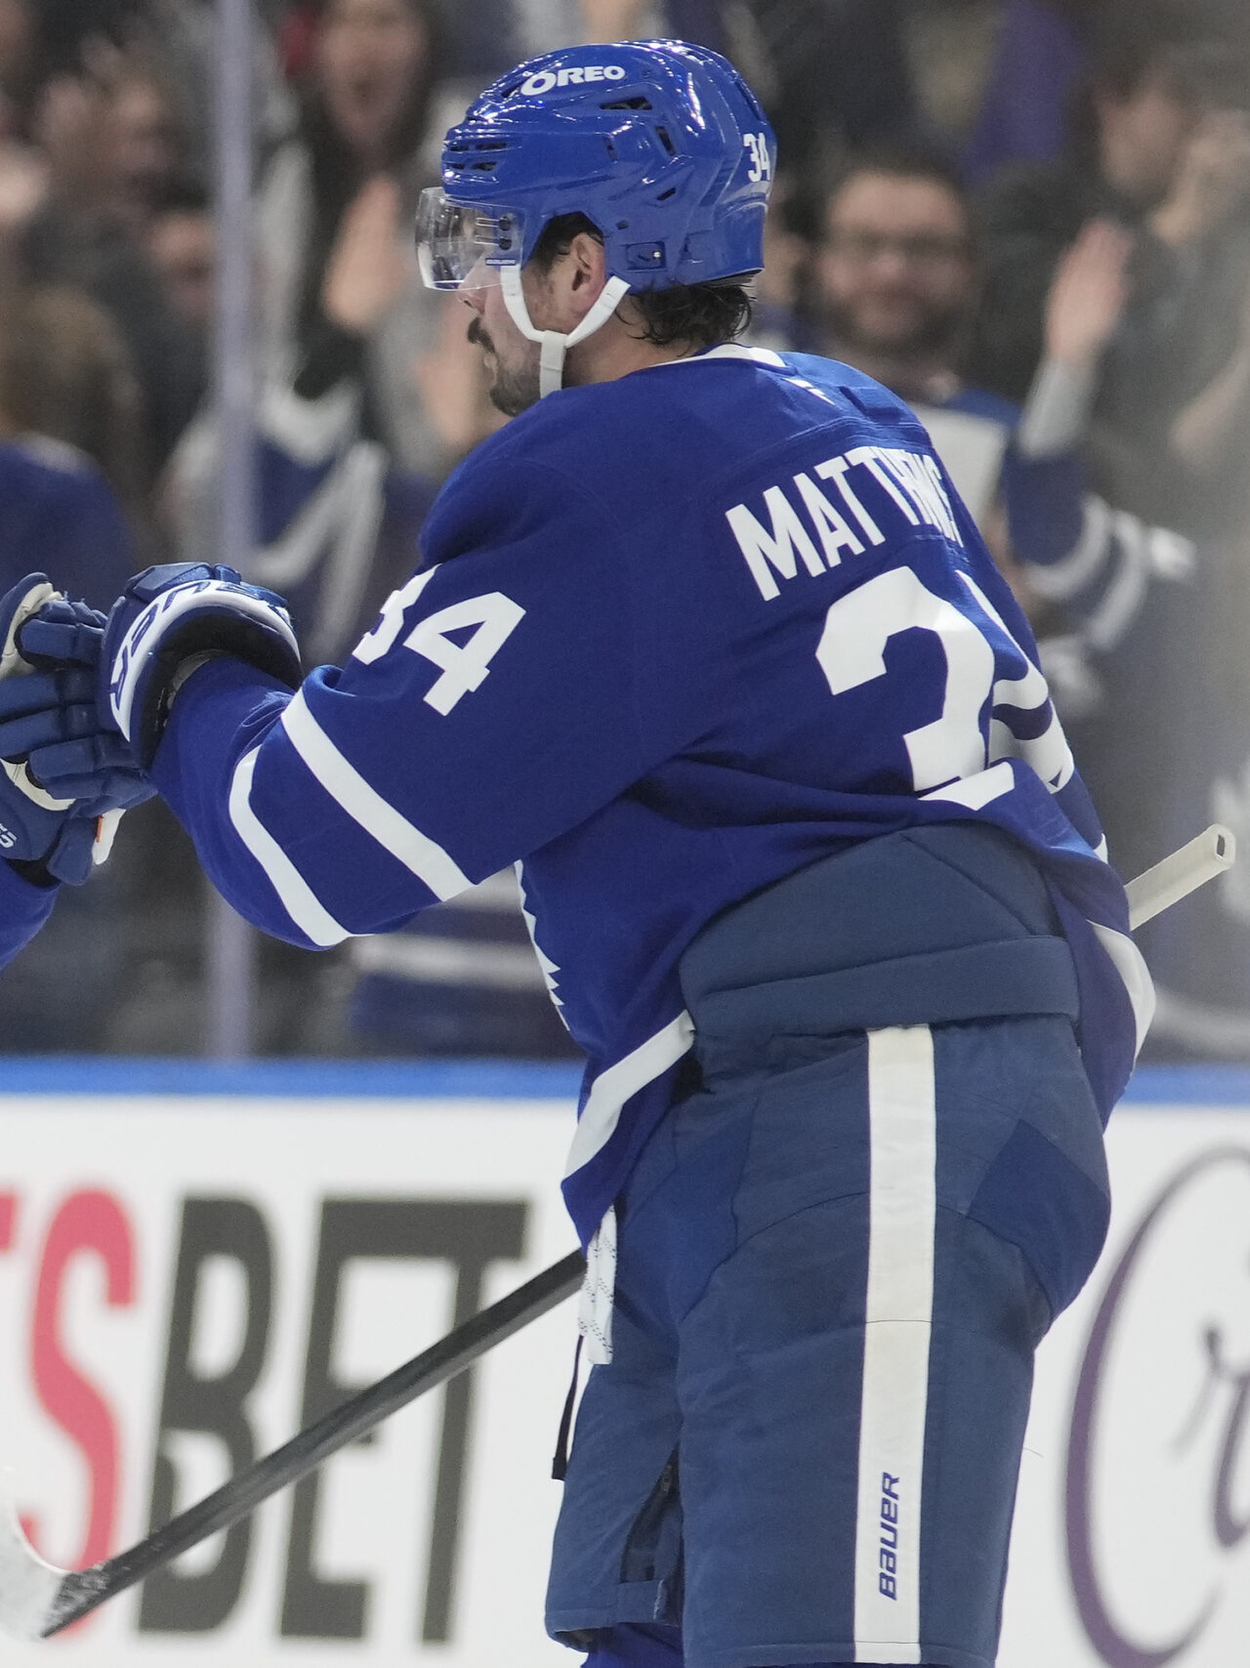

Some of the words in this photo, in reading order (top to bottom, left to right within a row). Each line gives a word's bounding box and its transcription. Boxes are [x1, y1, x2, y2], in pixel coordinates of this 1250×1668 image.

[521, 65, 626, 96] OREO
[743, 132, 771, 182] 34
[351, 563, 527, 717] 34
[879, 1471, 900, 1601] BAUER
